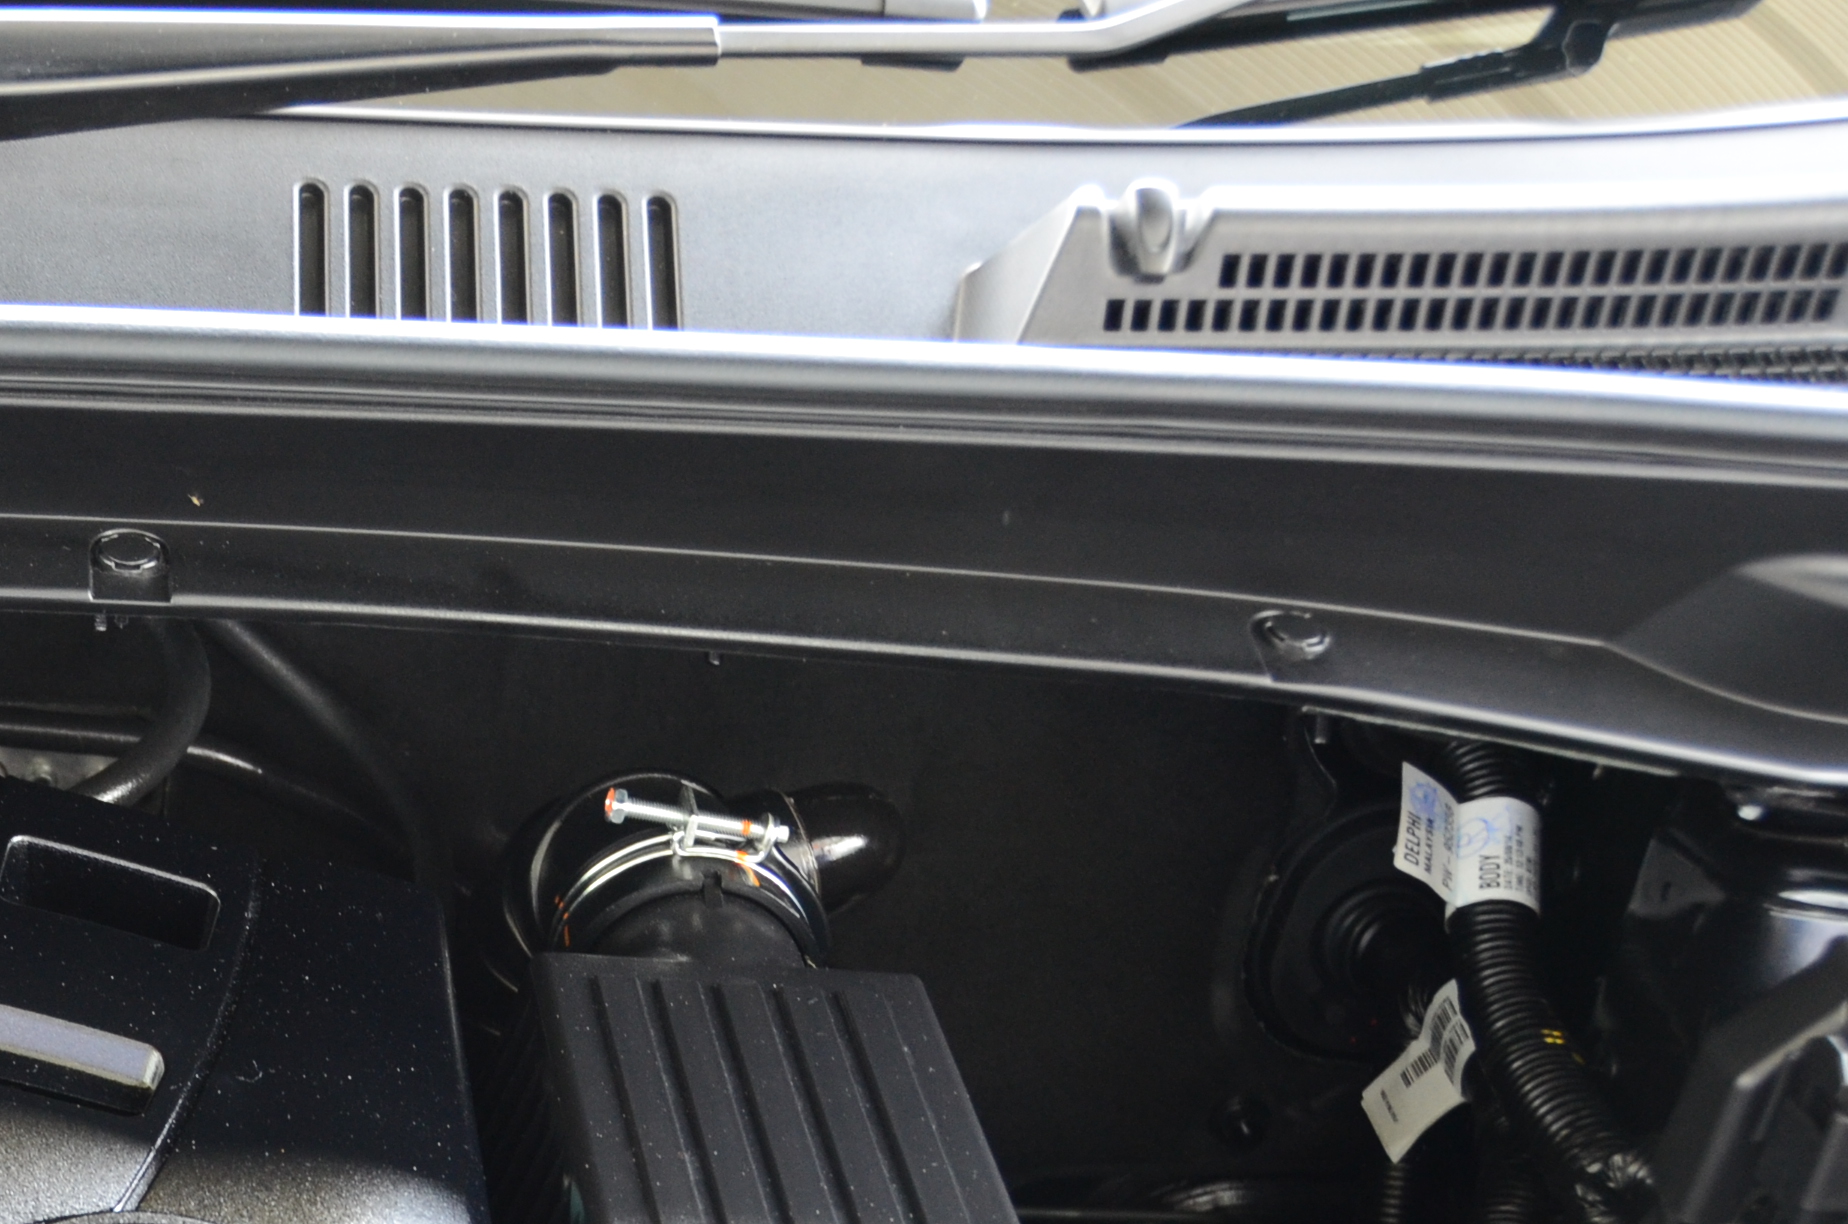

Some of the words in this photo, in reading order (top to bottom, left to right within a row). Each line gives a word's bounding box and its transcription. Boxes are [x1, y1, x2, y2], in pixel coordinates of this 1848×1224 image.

[1403, 811, 1422, 865] DELPHI
[1423, 817, 1436, 876] MALAYSIA
[1478, 854, 1502, 892] BODY
